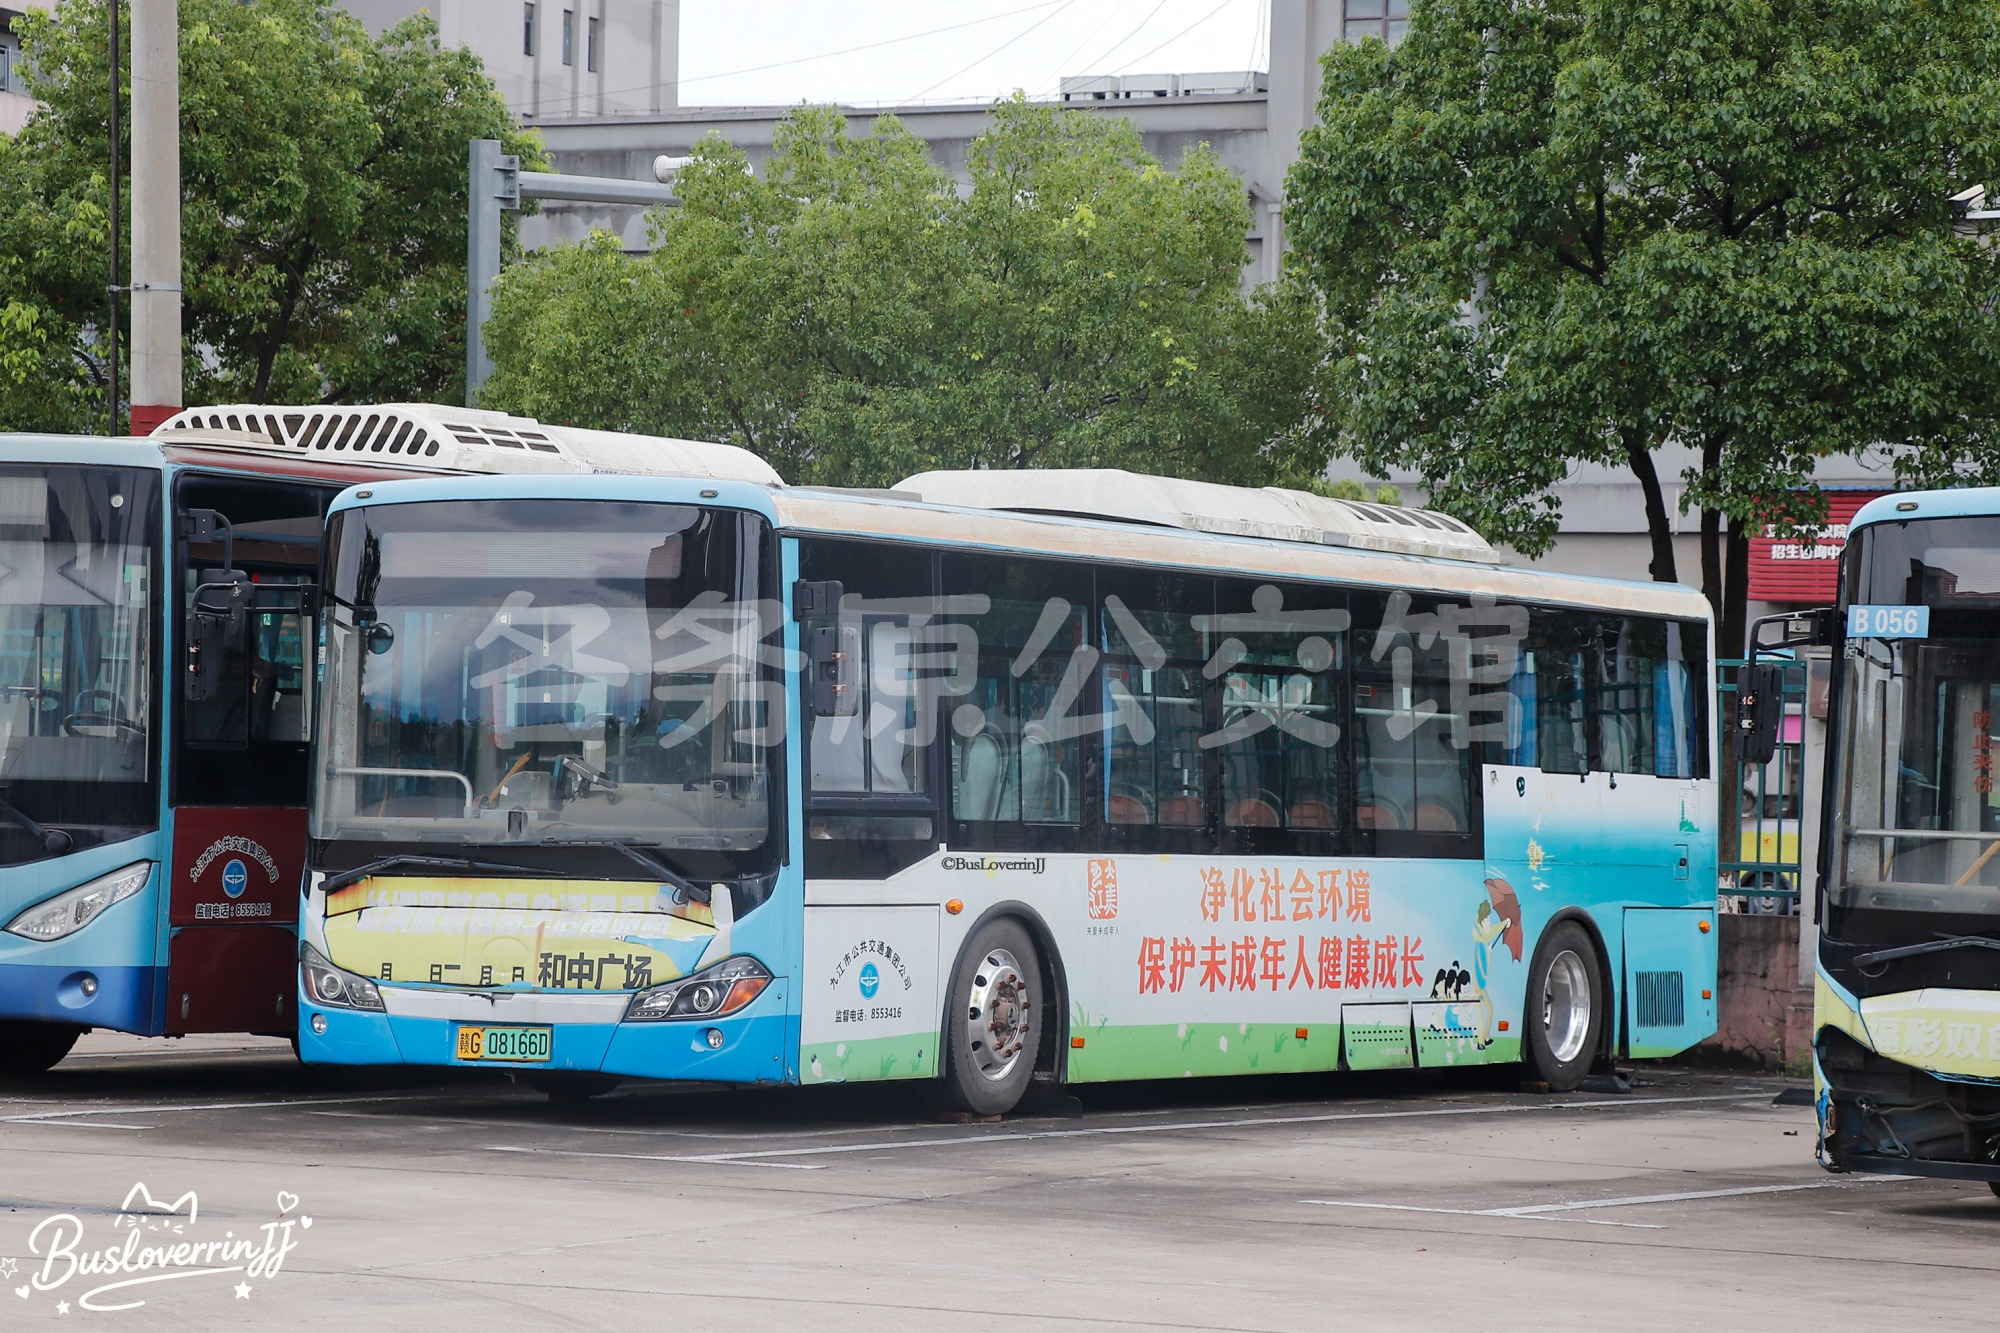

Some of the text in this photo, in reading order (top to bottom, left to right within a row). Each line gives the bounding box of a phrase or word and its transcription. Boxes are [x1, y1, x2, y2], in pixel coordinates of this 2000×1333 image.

[1855, 608, 1918, 635] B 056
[1972, 710, 1994, 793] 防止夹伤
[190, 836, 279, 883] 九江市公共交通集团公司
[1200, 866, 1371, 923] 净化社会环境
[538, 952, 652, 990] 和中广场
[829, 938, 912, 991] 九江市公共交通集团公司
[1137, 934, 1424, 994] 保护未成年人健康成长
[488, 1032, 548, 1056] 08166D
